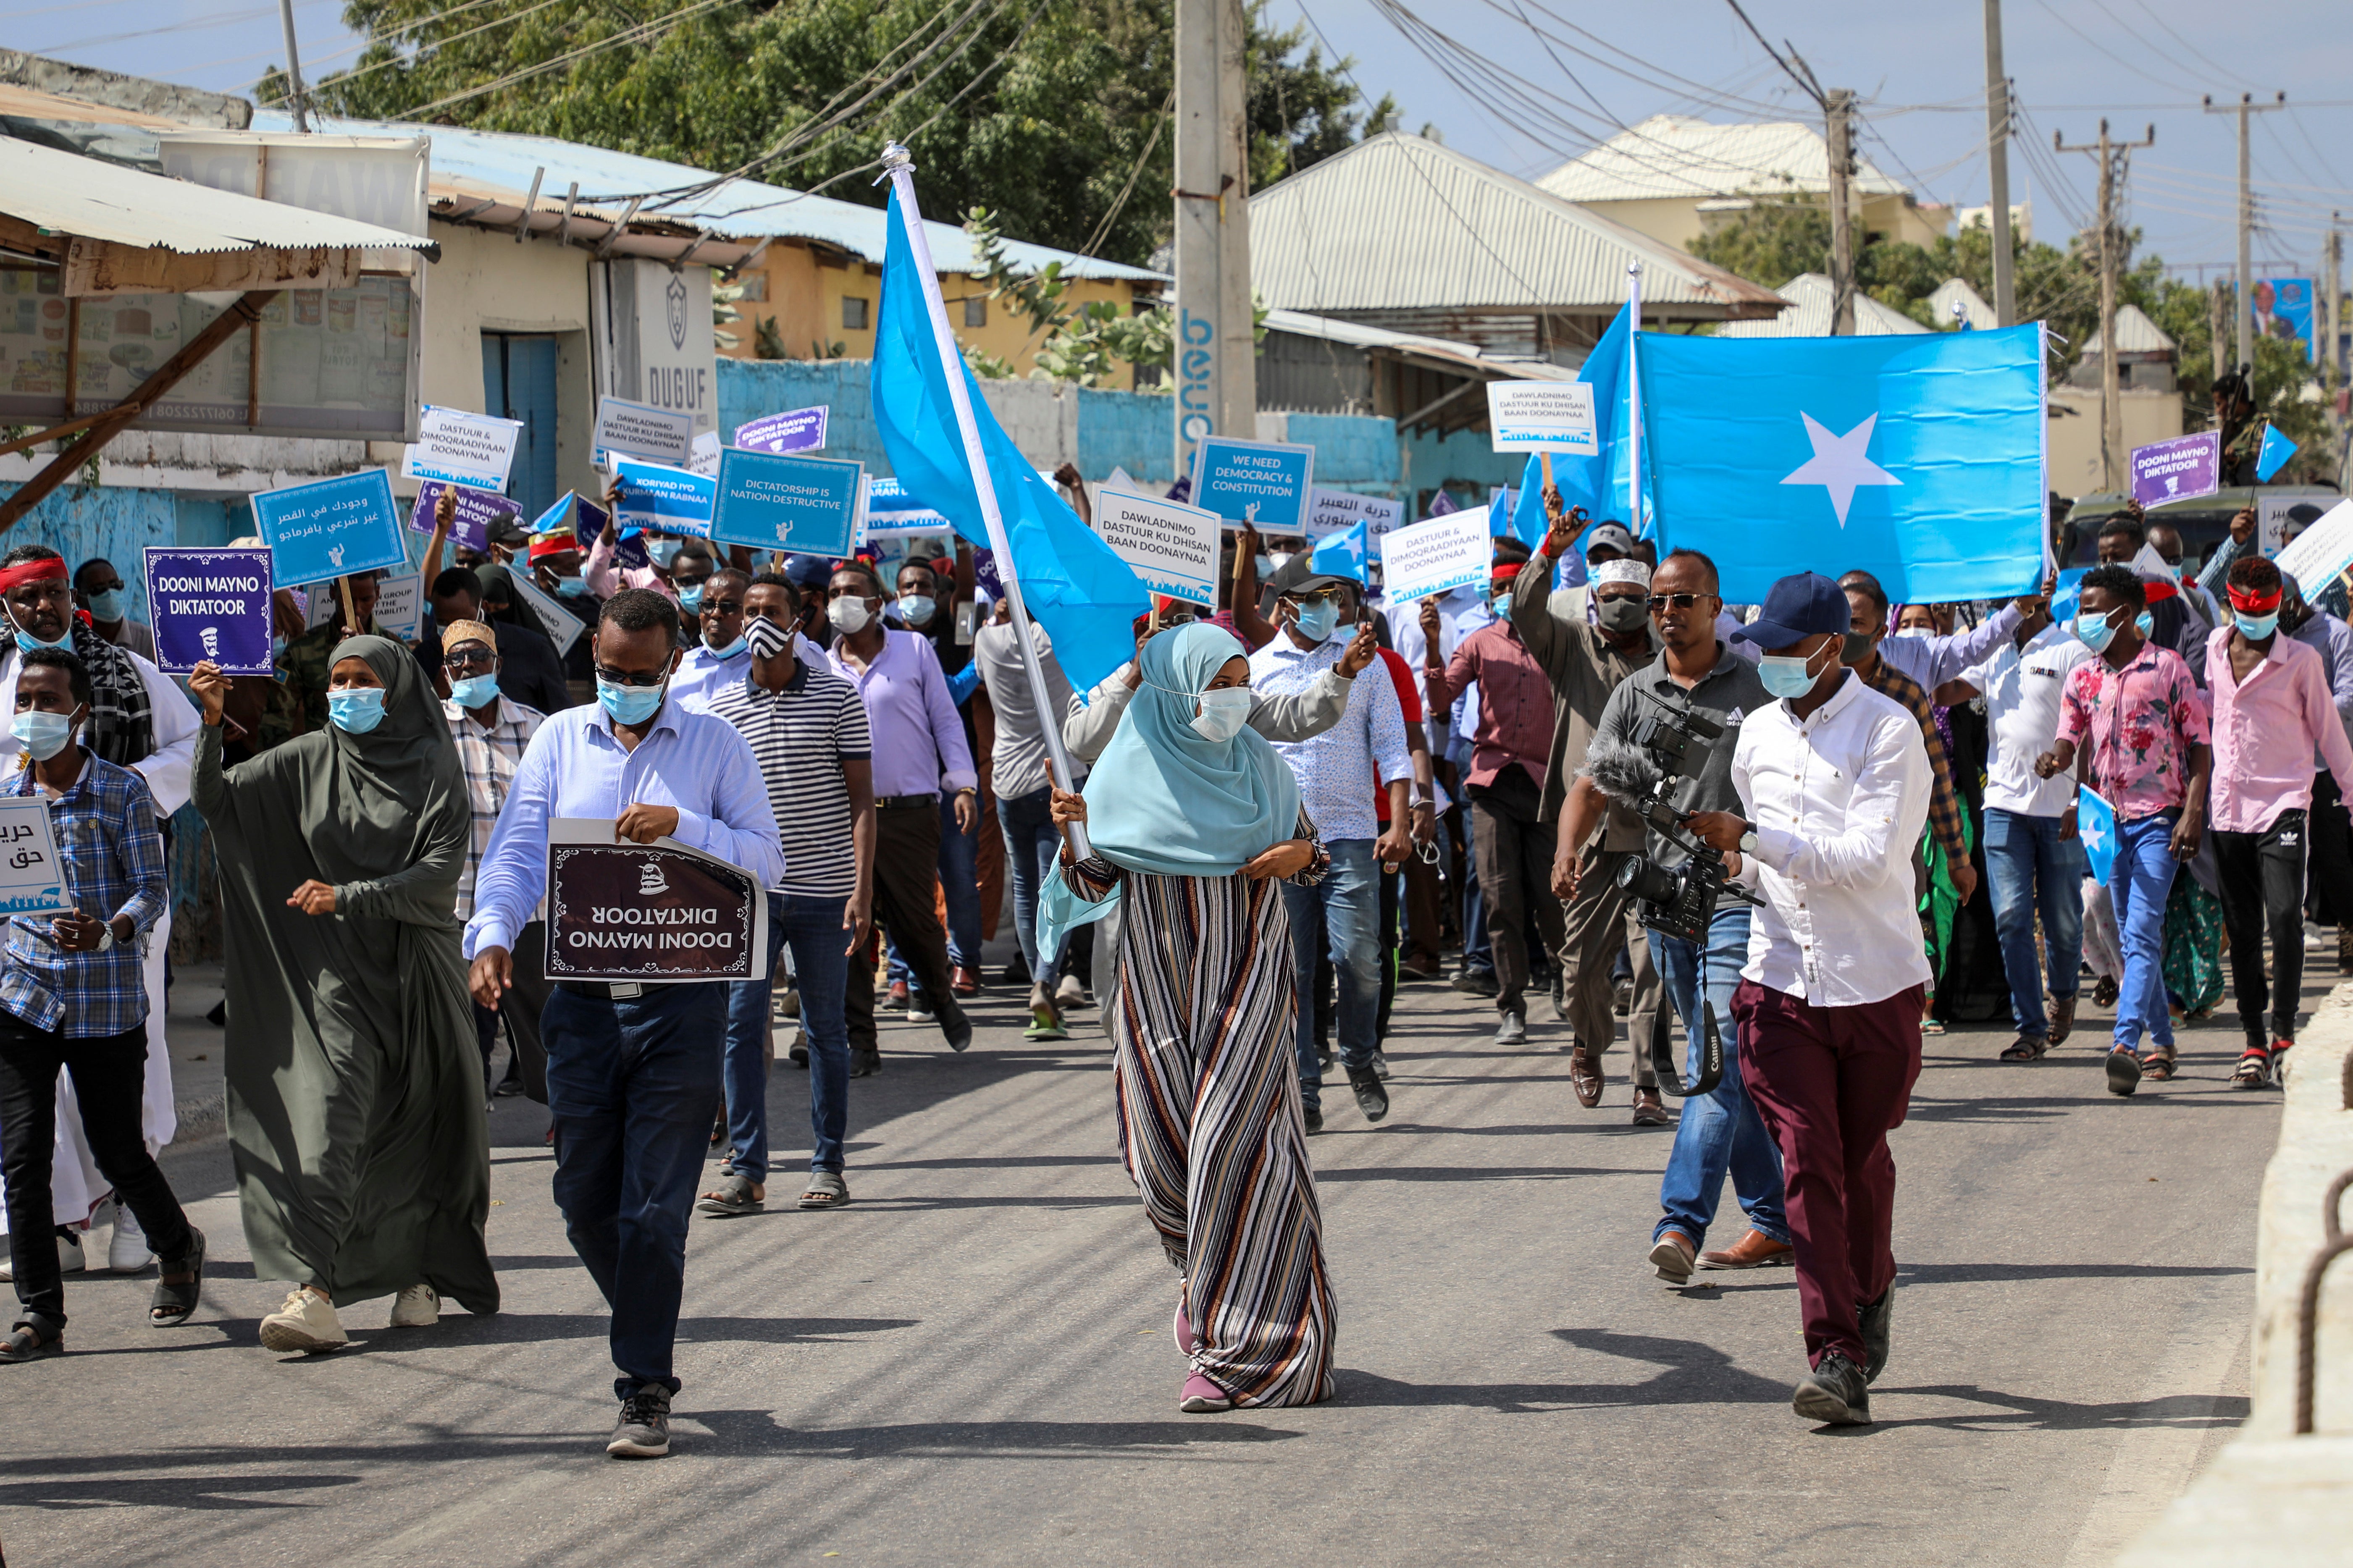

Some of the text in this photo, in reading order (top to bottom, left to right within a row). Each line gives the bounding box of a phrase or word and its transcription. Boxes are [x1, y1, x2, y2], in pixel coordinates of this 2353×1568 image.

[649, 367, 705, 409] DUGUF
[1513, 392, 1572, 400] DAWLADNIMO
[617, 414, 673, 430] DAWLADNIMO
[1530, 409, 1584, 418] DOONAYNAA
[440, 423, 490, 440] DASTUUR &
[603, 420, 639, 433] DASTUUR
[654, 430, 684, 441] DHISAN
[742, 416, 817, 441] DOONI MAYNO
[748, 425, 806, 446] DIKTATOOR
[420, 431, 505, 454] DIMOQRAADIYAAN
[605, 431, 680, 449] BAAN DOONAYNAA
[431, 444, 490, 462] DOONAYNAA
[1233, 455, 1281, 468] WE NEED
[2138, 446, 2209, 469] DOONI MAYNO
[1215, 467, 1292, 484] DEMOCRACY &
[2145, 459, 2198, 479] DIKTATOOR
[636, 477, 695, 492] XORIYAD IYO
[746, 479, 830, 497] DICTATORSHIP IS
[1212, 481, 1292, 497] CONSTITUTION
[670, 491, 708, 504] RABNAA
[730, 489, 841, 510] NATION DESTRUCTIVE
[278, 498, 368, 524] وجودك في القصر
[1318, 497, 1390, 518] حرية التعبير
[279, 511, 378, 542] غير شرعي يافرماجو
[1121, 511, 1196, 535] DAWLADNIMO
[1370, 522, 1389, 535] حق
[1103, 521, 1211, 553] DASTUUR KU DHISAN
[1407, 527, 1460, 548] DASTUUR &
[1107, 535, 1206, 565] BAAN DOONAYNAA
[1390, 533, 1480, 565] DIMOQRAADIYAAN
[1405, 548, 1466, 572] DOONAYNAA
[159, 576, 259, 592] DOONI MAYNO
[384, 589, 412, 598] GROUP
[170, 599, 246, 615] DIKTATOOR
[375, 606, 408, 616] TABILITY
[0, 825, 34, 842] حري
[10, 847, 44, 869] حق
[591, 907, 717, 925] DIKTATOOR
[569, 931, 732, 949] DOONI MAYNO
